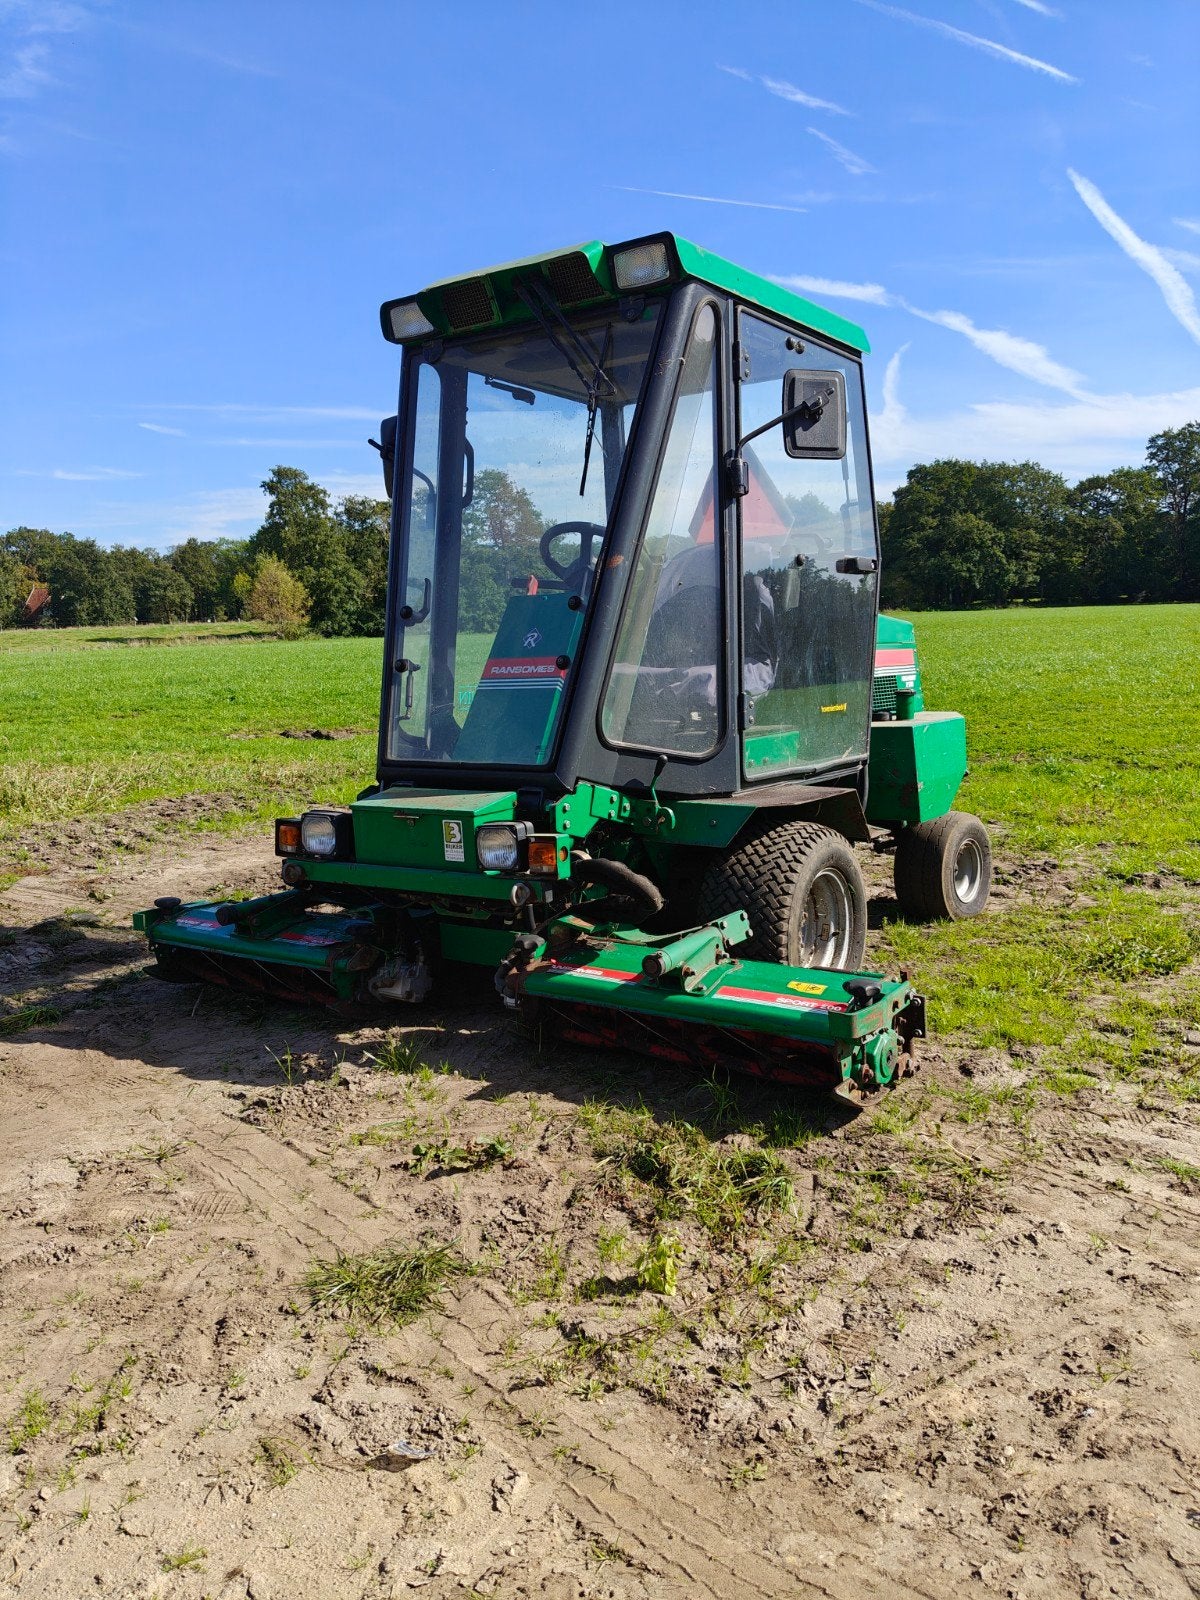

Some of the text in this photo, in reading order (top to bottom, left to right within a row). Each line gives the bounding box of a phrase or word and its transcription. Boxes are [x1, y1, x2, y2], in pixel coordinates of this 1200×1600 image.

[523, 632, 538, 647] R
[490, 665, 556, 674] RANSOMES
[775, 997, 818, 1008] SPORT
